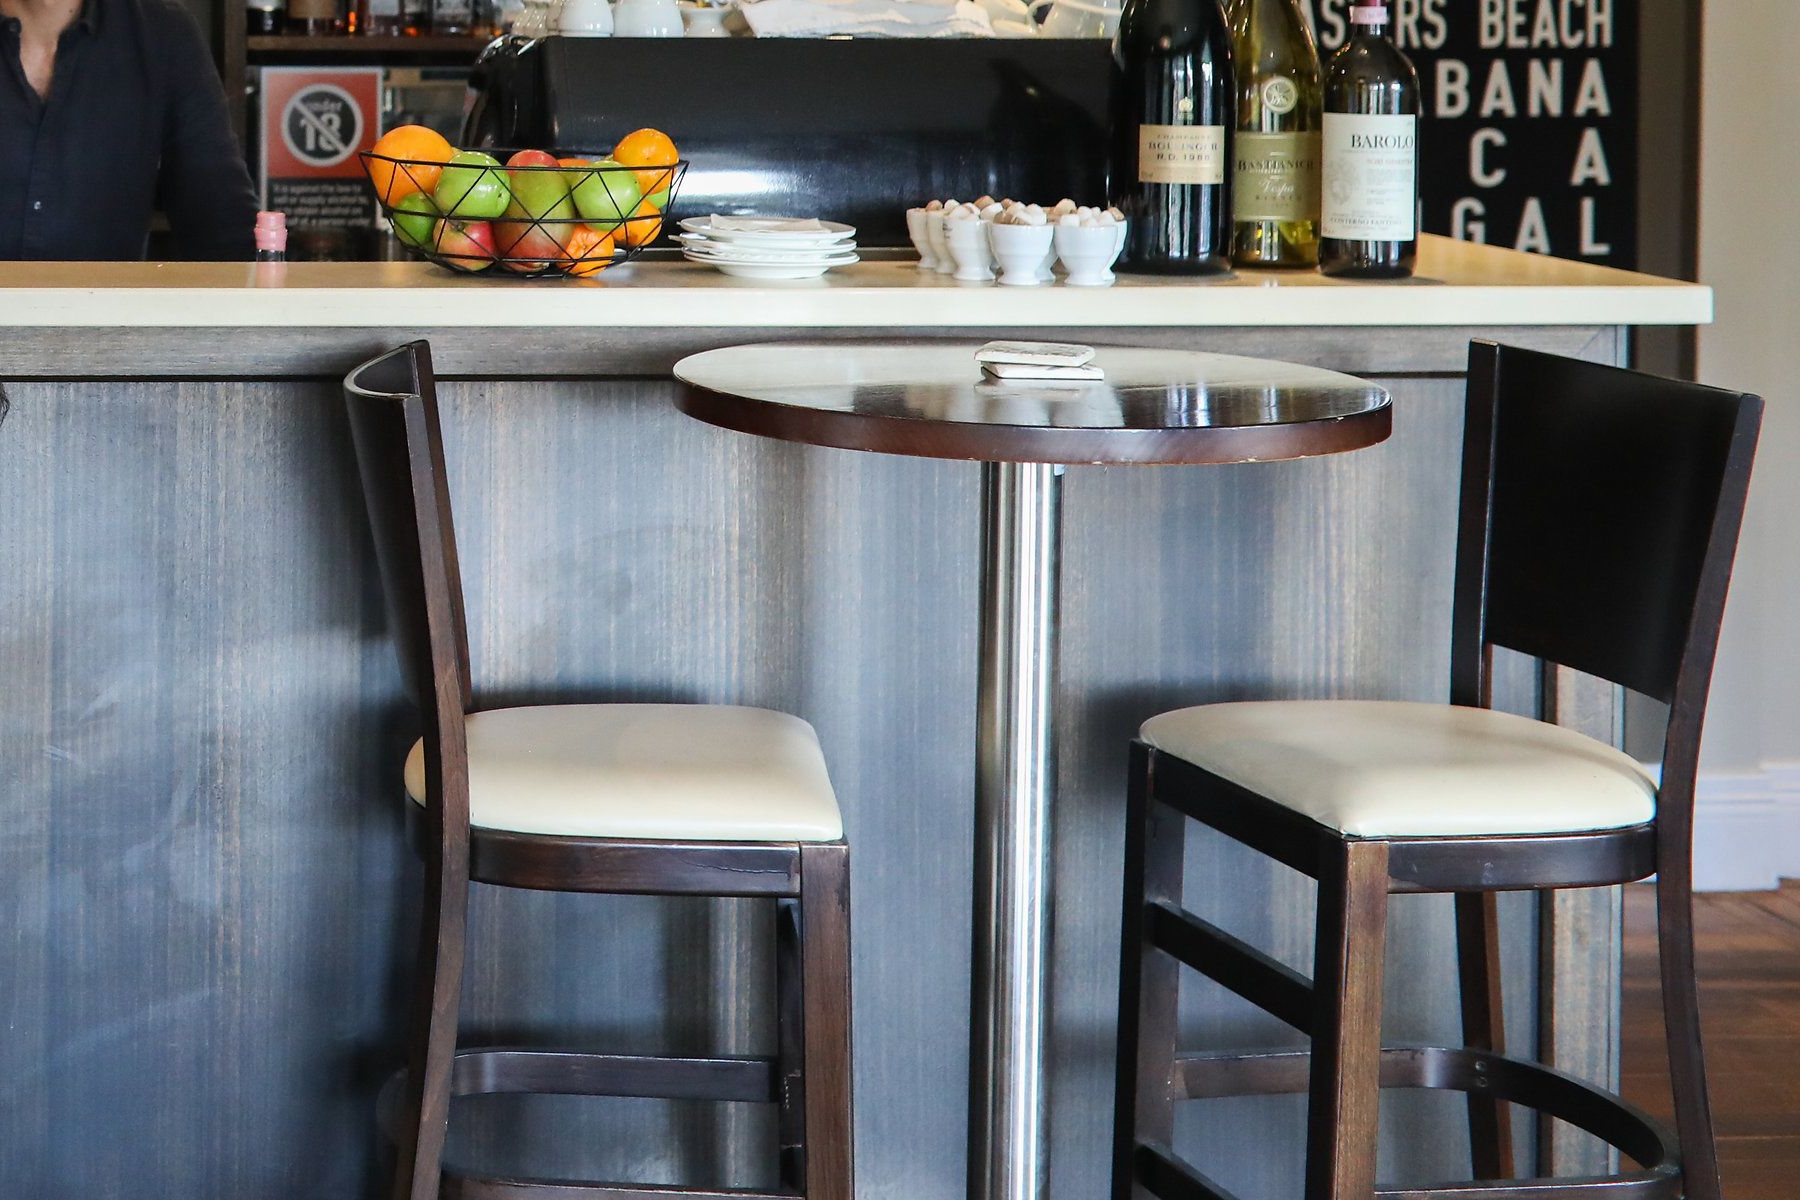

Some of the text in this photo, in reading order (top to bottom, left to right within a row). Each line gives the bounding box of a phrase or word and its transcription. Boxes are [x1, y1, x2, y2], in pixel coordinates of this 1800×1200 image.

[1422, 57, 1611, 118] BANA
[1351, 133, 1414, 149] BAROLO
[1450, 196, 1611, 256] GAL
